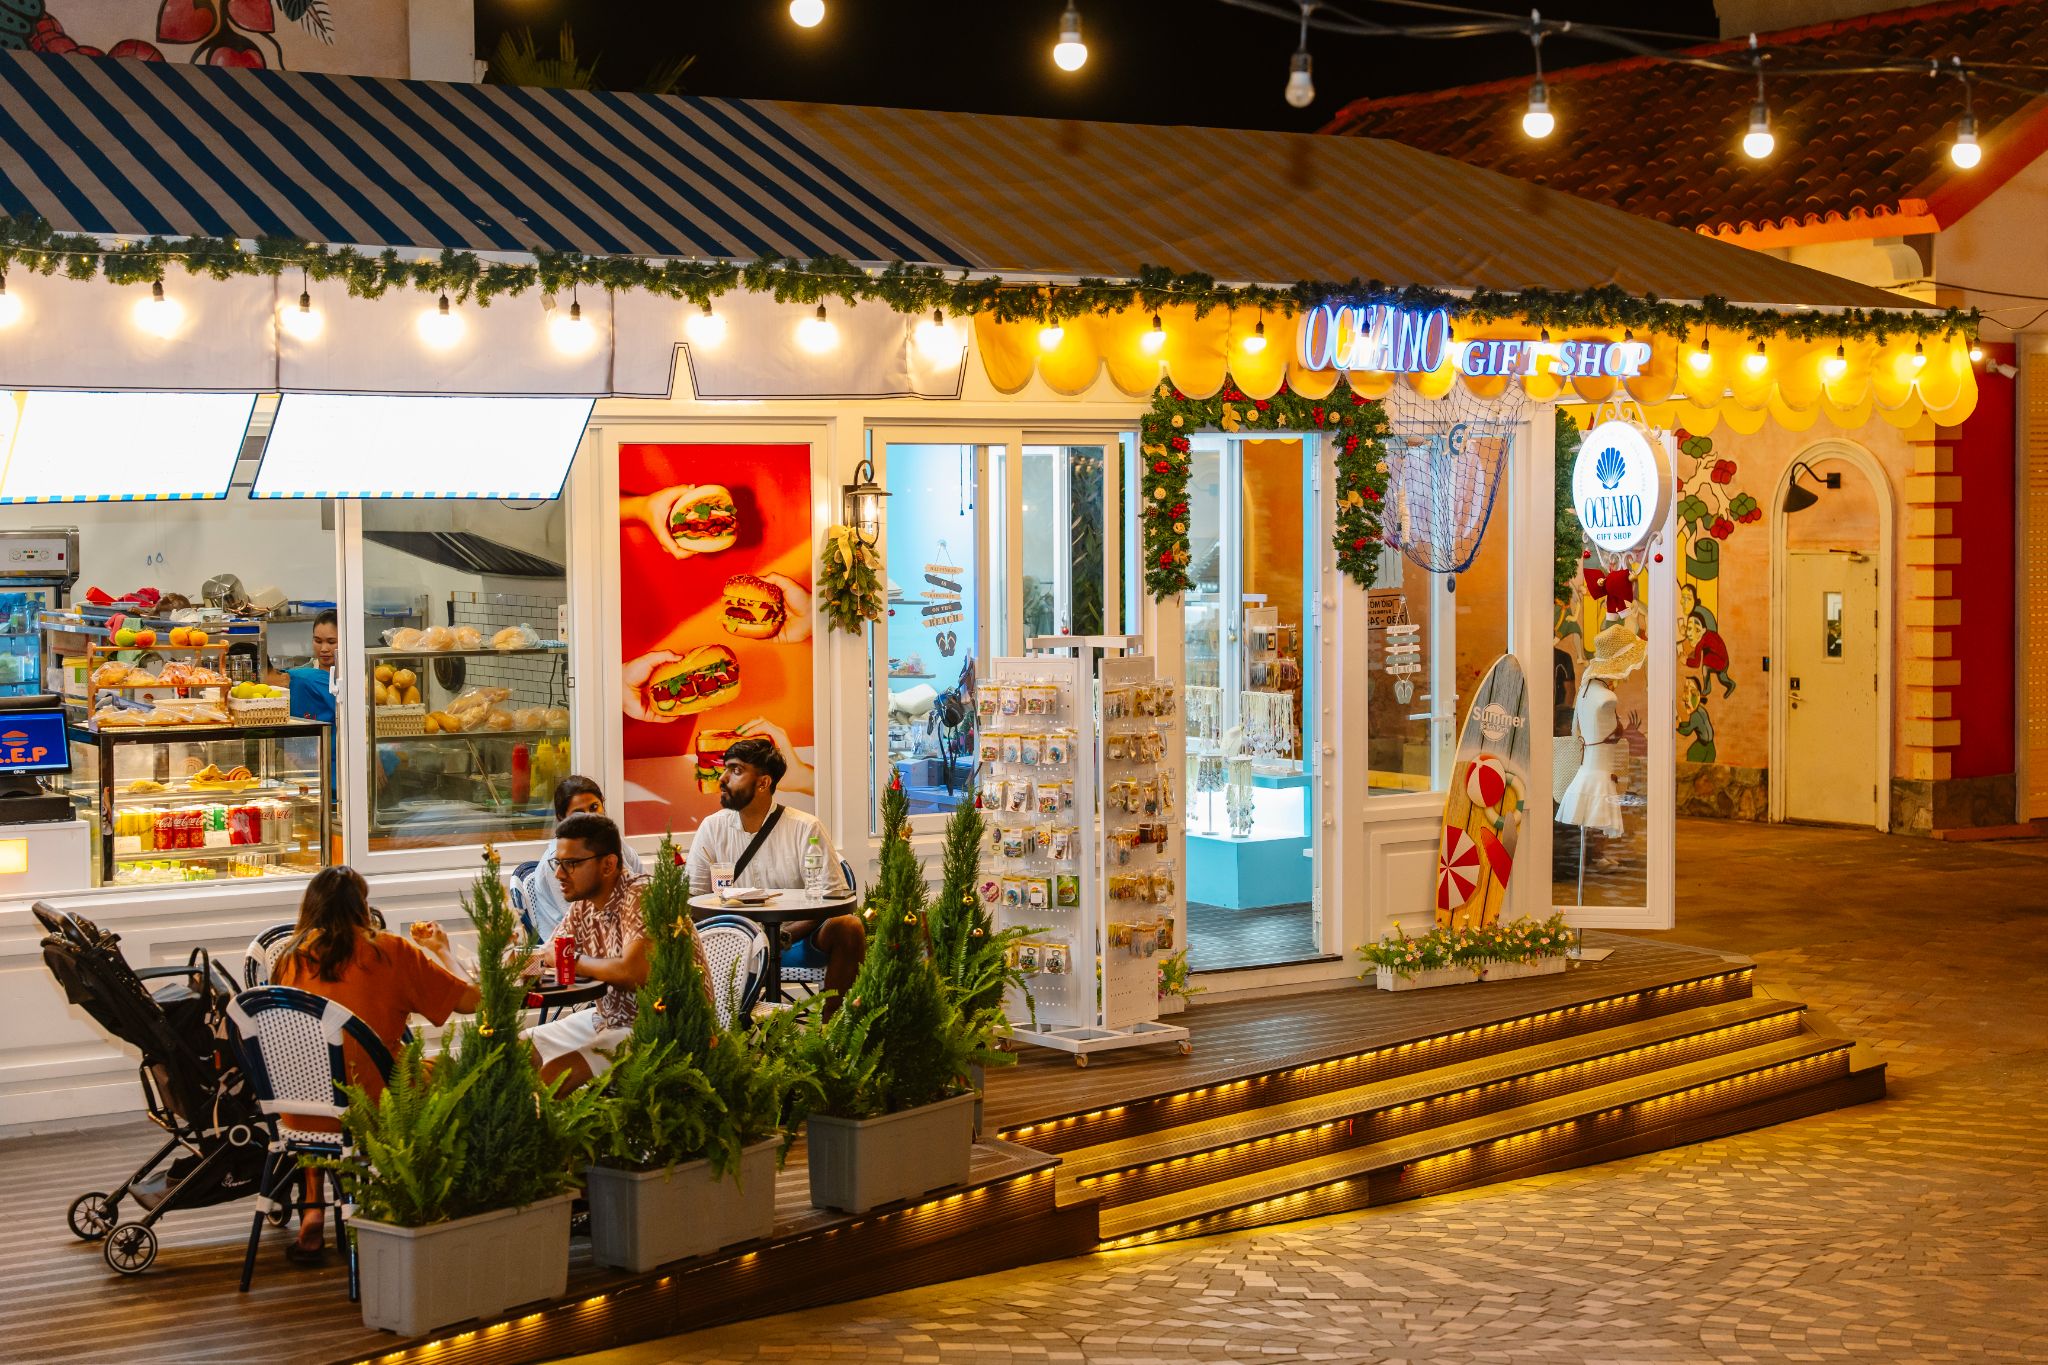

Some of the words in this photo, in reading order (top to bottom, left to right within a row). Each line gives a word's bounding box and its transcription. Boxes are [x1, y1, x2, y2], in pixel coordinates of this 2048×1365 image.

[1461, 340, 1540, 377] GIFT
[1559, 340, 1652, 378] SHOP
[1584, 494, 1642, 528] OCEANO
[1596, 533, 1611, 541] GIFT
[1613, 531, 1632, 540] SHOP
[1472, 706, 1525, 728] Summer
